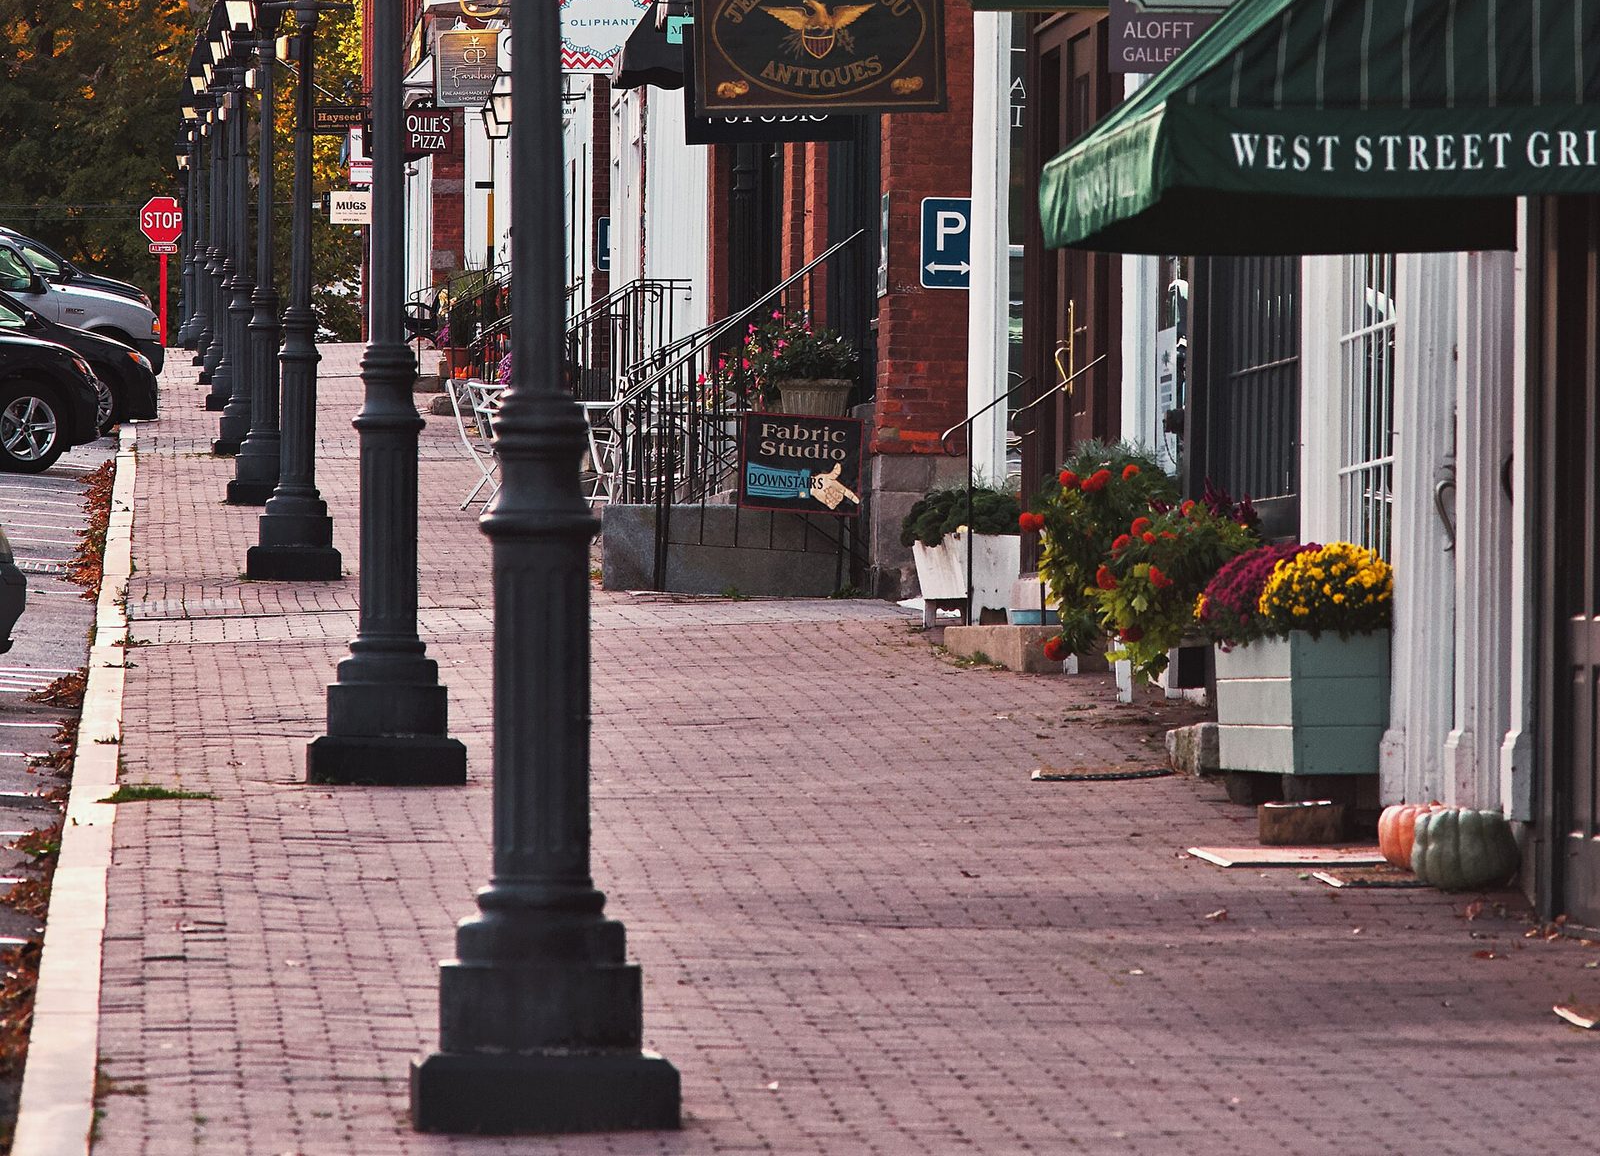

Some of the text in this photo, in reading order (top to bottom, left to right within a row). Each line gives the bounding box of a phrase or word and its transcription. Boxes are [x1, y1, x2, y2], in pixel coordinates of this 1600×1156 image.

[570, 18, 637, 27] OLIPHANT
[1123, 21, 1194, 39] ALOFFT
[464, 49, 487, 64] CP
[759, 55, 883, 89] ANTIQUES
[317, 112, 362, 123] Hayseed
[406, 115, 451, 133] OLLIE'S
[411, 133, 446, 150] PIZZA
[1230, 130, 1598, 172] WEST STREET GRI
[336, 201, 367, 210] MUGS
[143, 212, 183, 229] STOP
[936, 211, 967, 251] P
[760, 423, 846, 443] Fabric
[759, 440, 846, 461] Studio
[748, 473, 824, 490] DOWNSTAIRS
